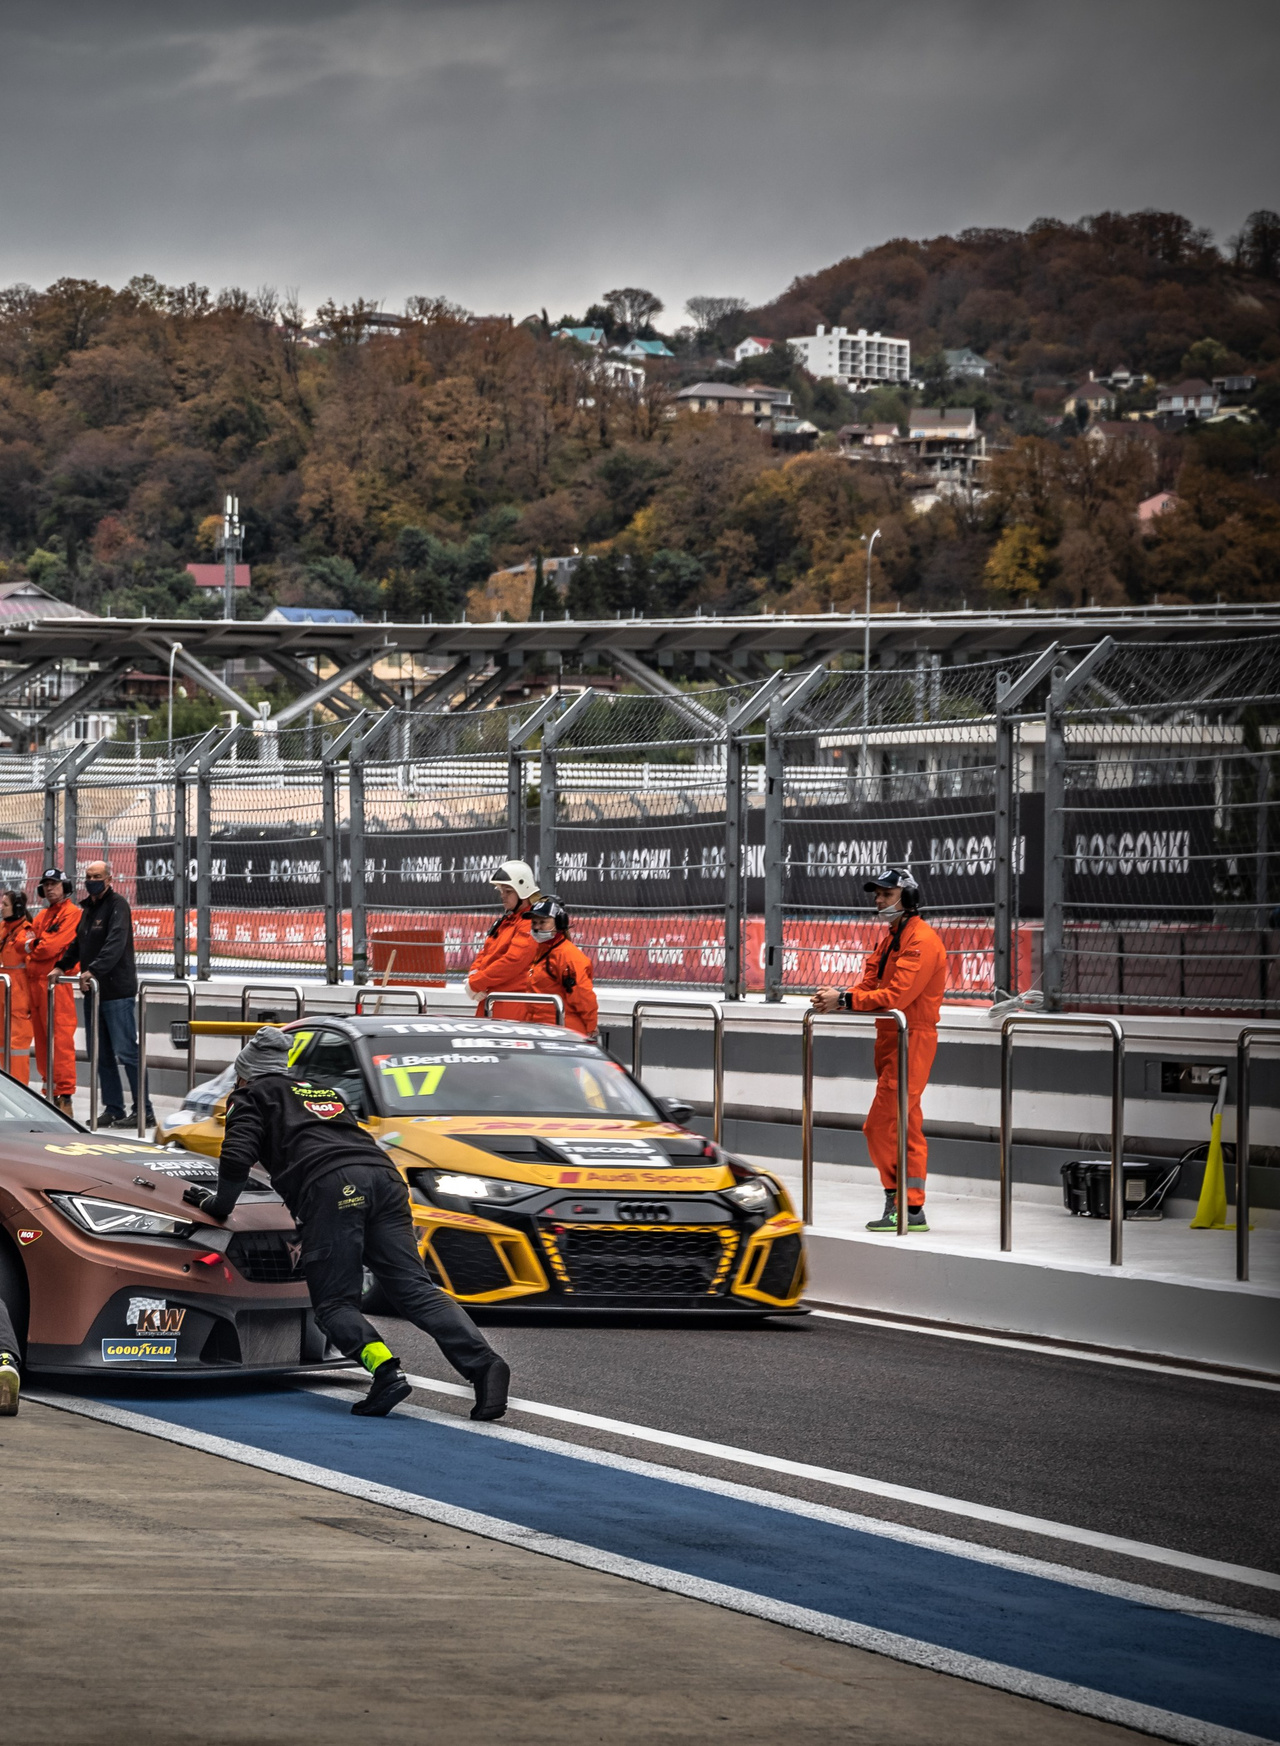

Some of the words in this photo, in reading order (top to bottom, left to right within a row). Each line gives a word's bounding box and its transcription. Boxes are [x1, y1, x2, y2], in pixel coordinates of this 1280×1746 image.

[1075, 830, 1190, 876] ROSGONKI
[382, 1023, 568, 1037] TRICORP
[382, 1065, 447, 1098] 17
[586, 1172, 638, 1182] Audi
[640, 1172, 708, 1185] Sport
[136, 1308, 186, 1332] KW
[106, 1343, 172, 1358] GOODYEAR
